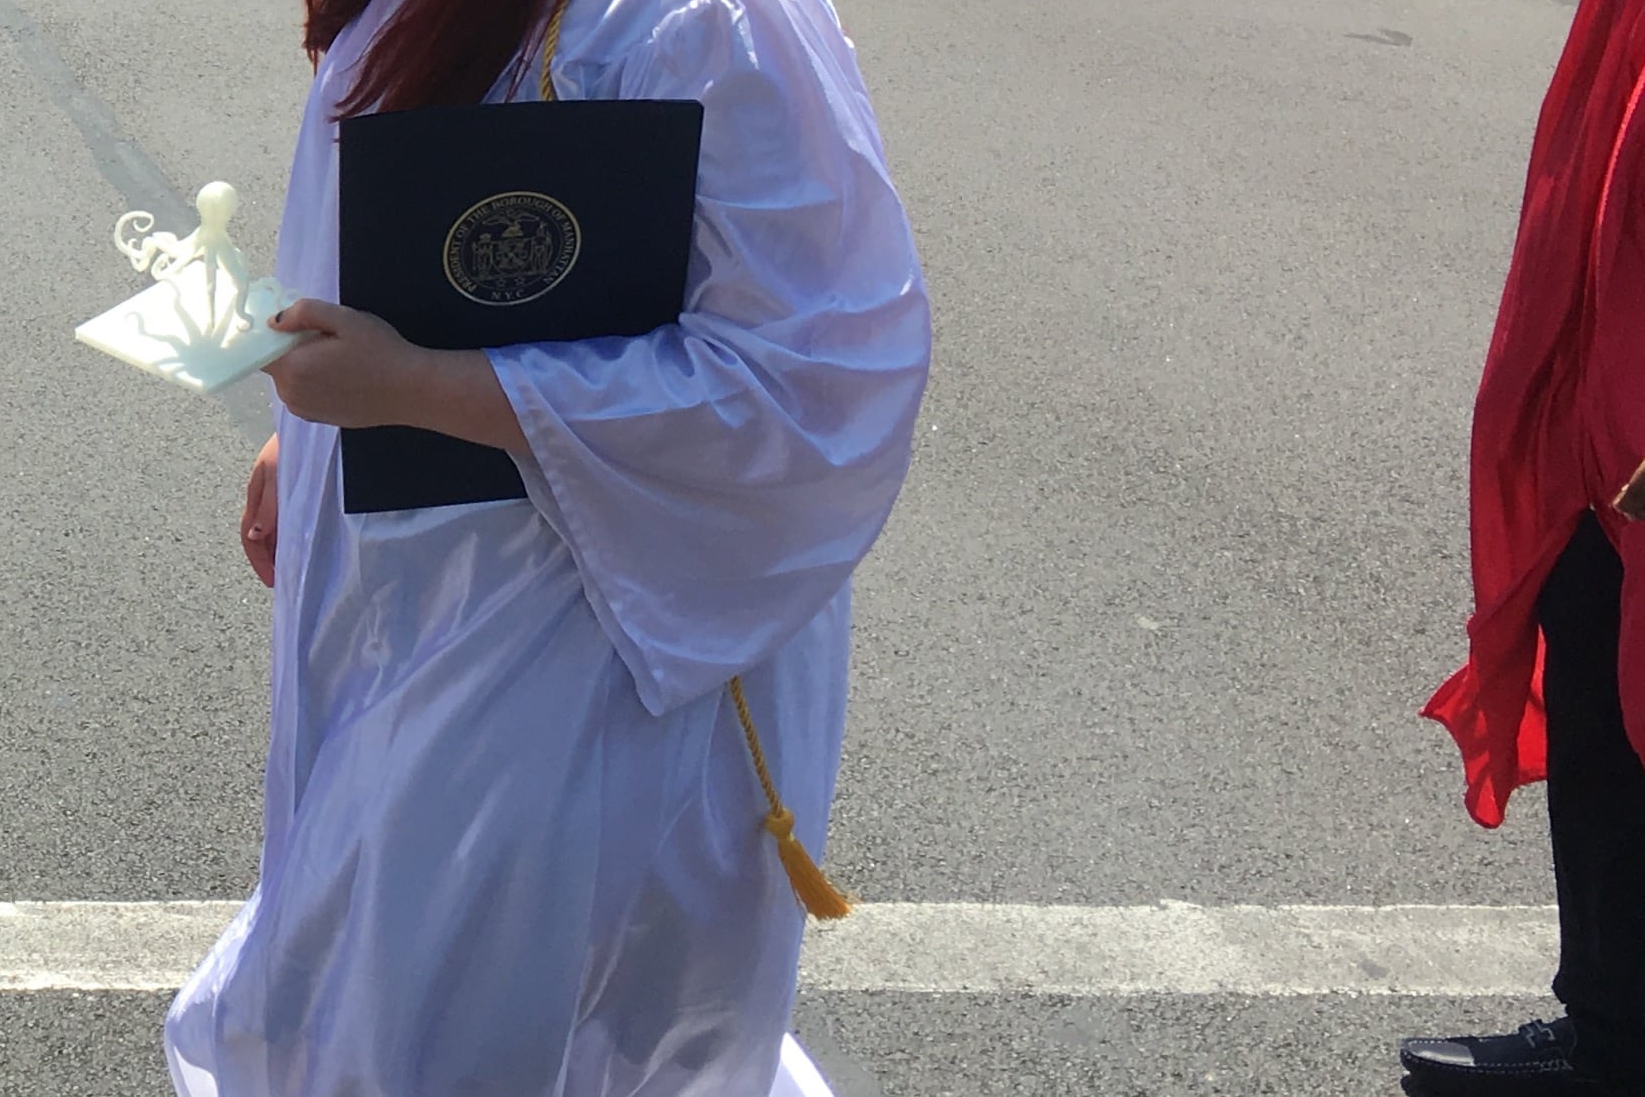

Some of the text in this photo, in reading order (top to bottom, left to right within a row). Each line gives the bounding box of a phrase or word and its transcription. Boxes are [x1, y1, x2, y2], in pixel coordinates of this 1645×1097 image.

[492, 197, 552, 212] BOROUGH
[467, 206, 490, 224] THE
[551, 209, 567, 221] OF
[456, 223, 469, 239] OF
[542, 221, 575, 285] MANHATTAN
